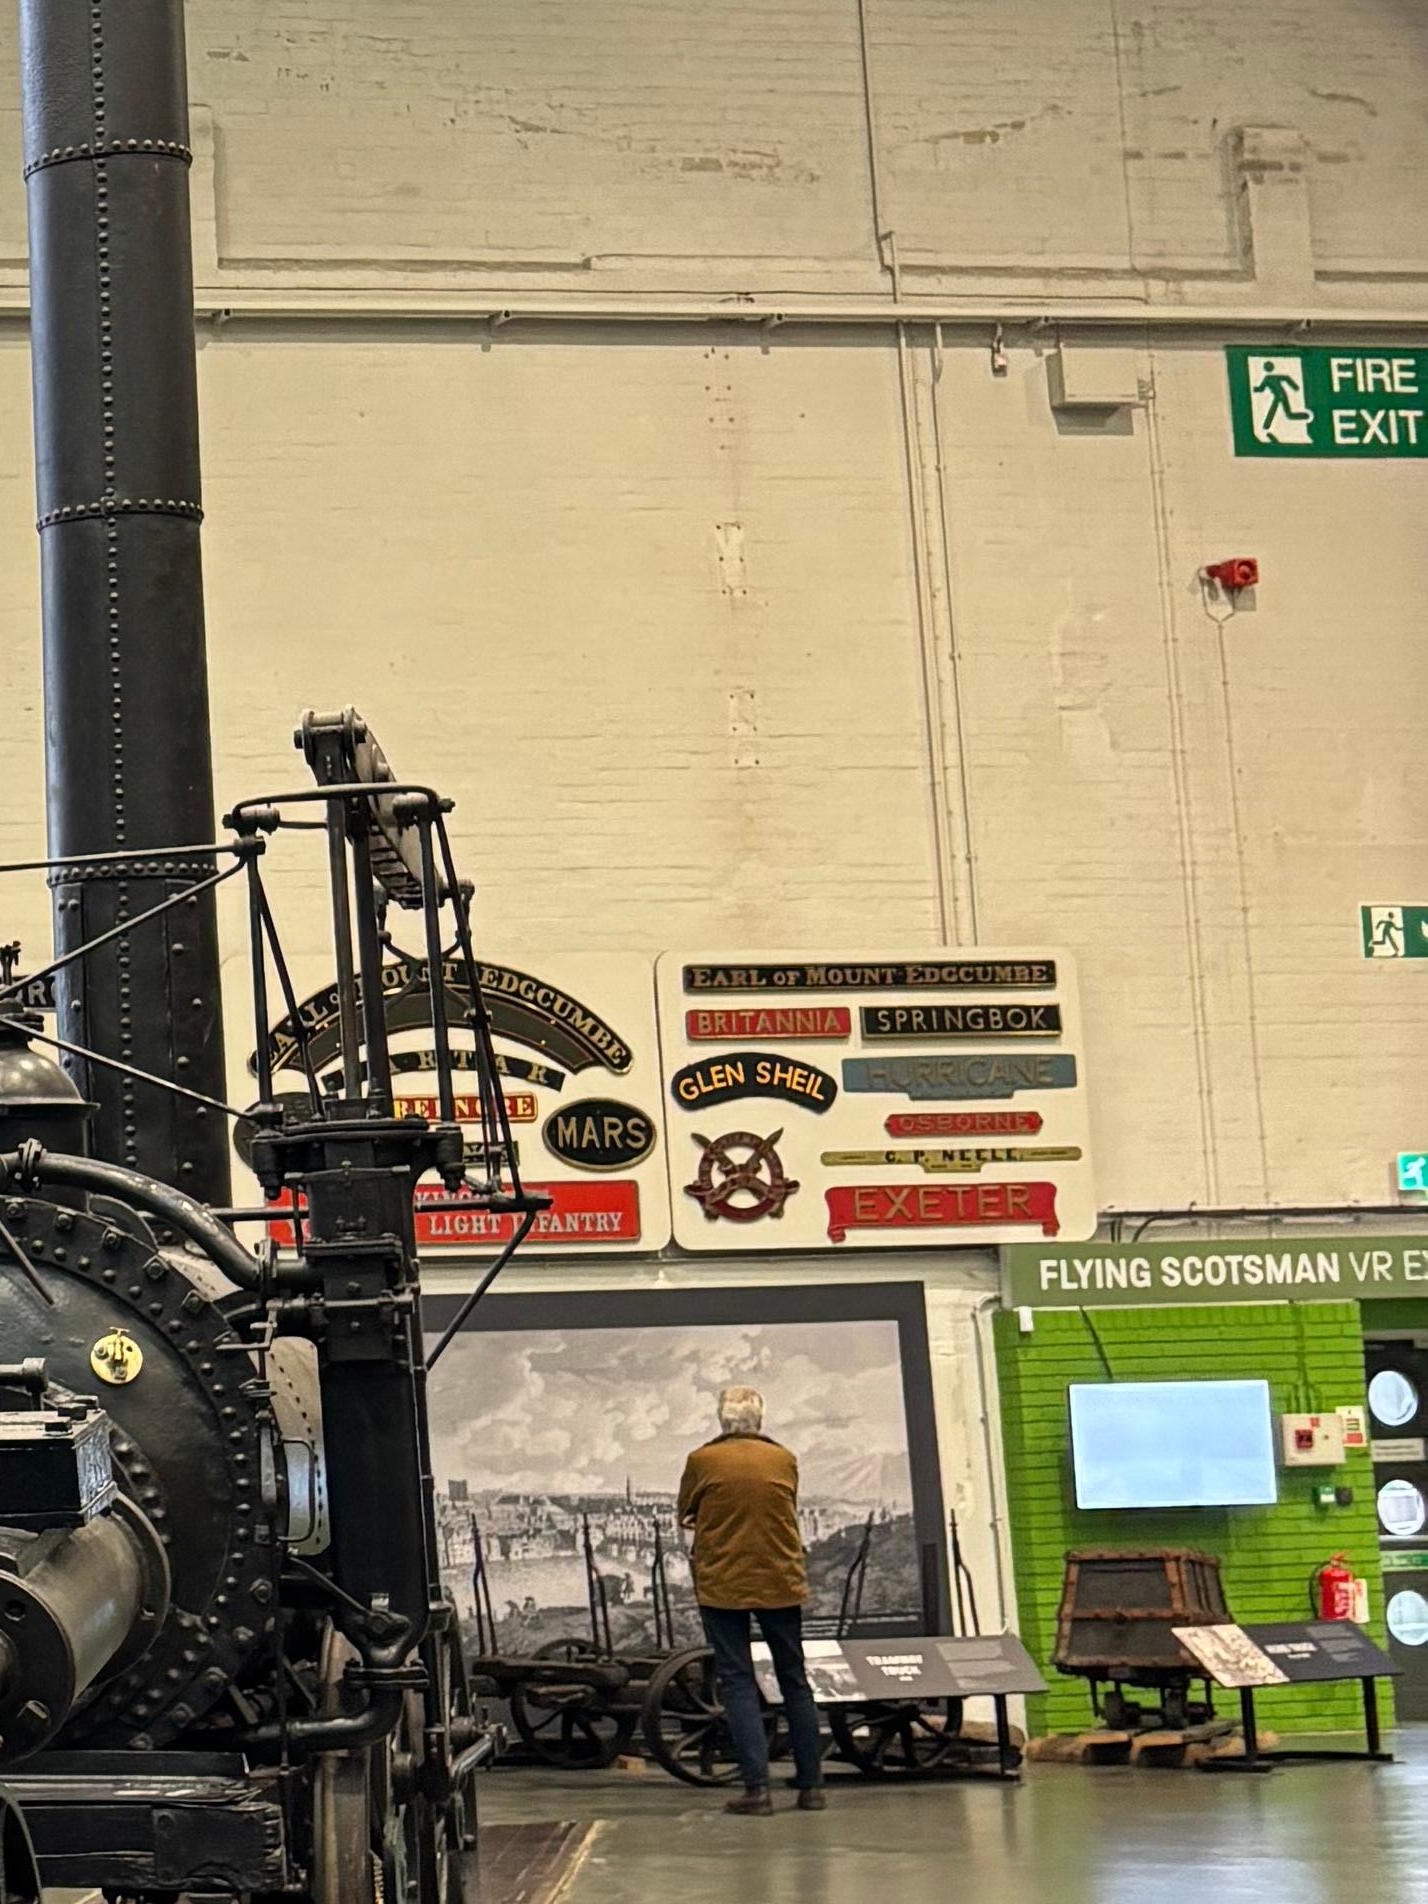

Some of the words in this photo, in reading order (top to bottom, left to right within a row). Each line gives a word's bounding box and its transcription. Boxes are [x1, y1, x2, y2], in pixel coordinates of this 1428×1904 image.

[1330, 357, 1419, 393] FIRE
[1332, 409, 1423, 445] EXIT
[694, 968, 767, 987] EARL
[805, 966, 896, 986] MOUNT
[480, 965, 627, 1065] EDGCUMBE
[697, 1010, 841, 1034] BRITANNIA
[877, 1007, 1047, 1031] SPRINGBOK
[679, 1061, 745, 1100] GLEN
[756, 1061, 825, 1101] SHEIL
[864, 1055, 1054, 1088] HURRICANE
[557, 1116, 646, 1149] MARS
[899, 1112, 1031, 1131] OSBORNE
[853, 1184, 1032, 1221] EXETER
[430, 1212, 501, 1235] LIGHT
[1039, 1257, 1152, 1291] FLYING
[1160, 1252, 1341, 1288] SCOTSMAN
[1348, 1250, 1393, 1282] VR
